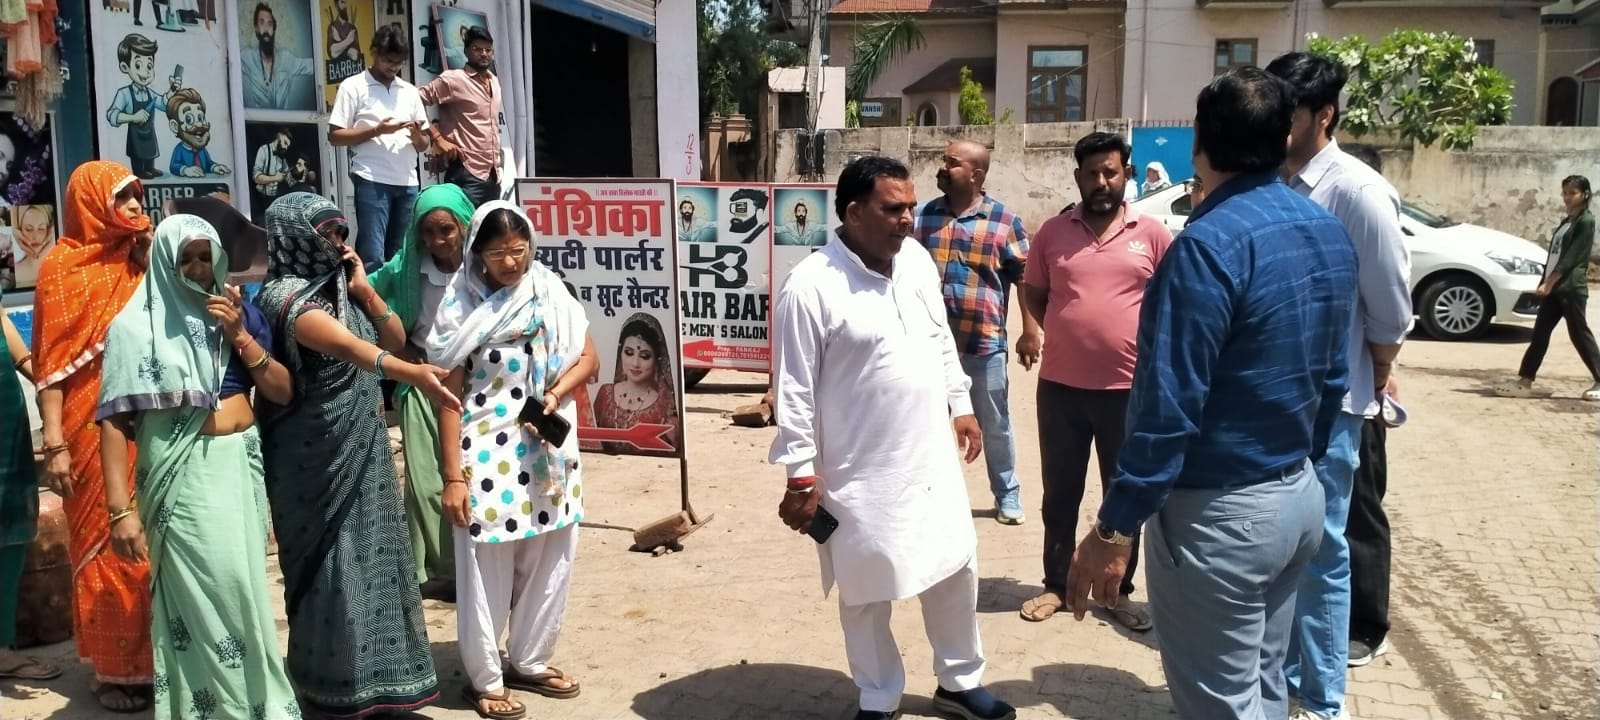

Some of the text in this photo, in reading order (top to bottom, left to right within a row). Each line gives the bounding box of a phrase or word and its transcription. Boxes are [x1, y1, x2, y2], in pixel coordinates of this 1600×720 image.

[329, 60, 363, 80] BARBER
[142, 186, 194, 208] RBER
[523, 186, 665, 237] वंशिका
[593, 239, 665, 271] पार्लर
[580, 277, 670, 317] व सूट सैन्टर
[680, 291, 717, 319] AIR
[730, 325, 768, 340] SALON
